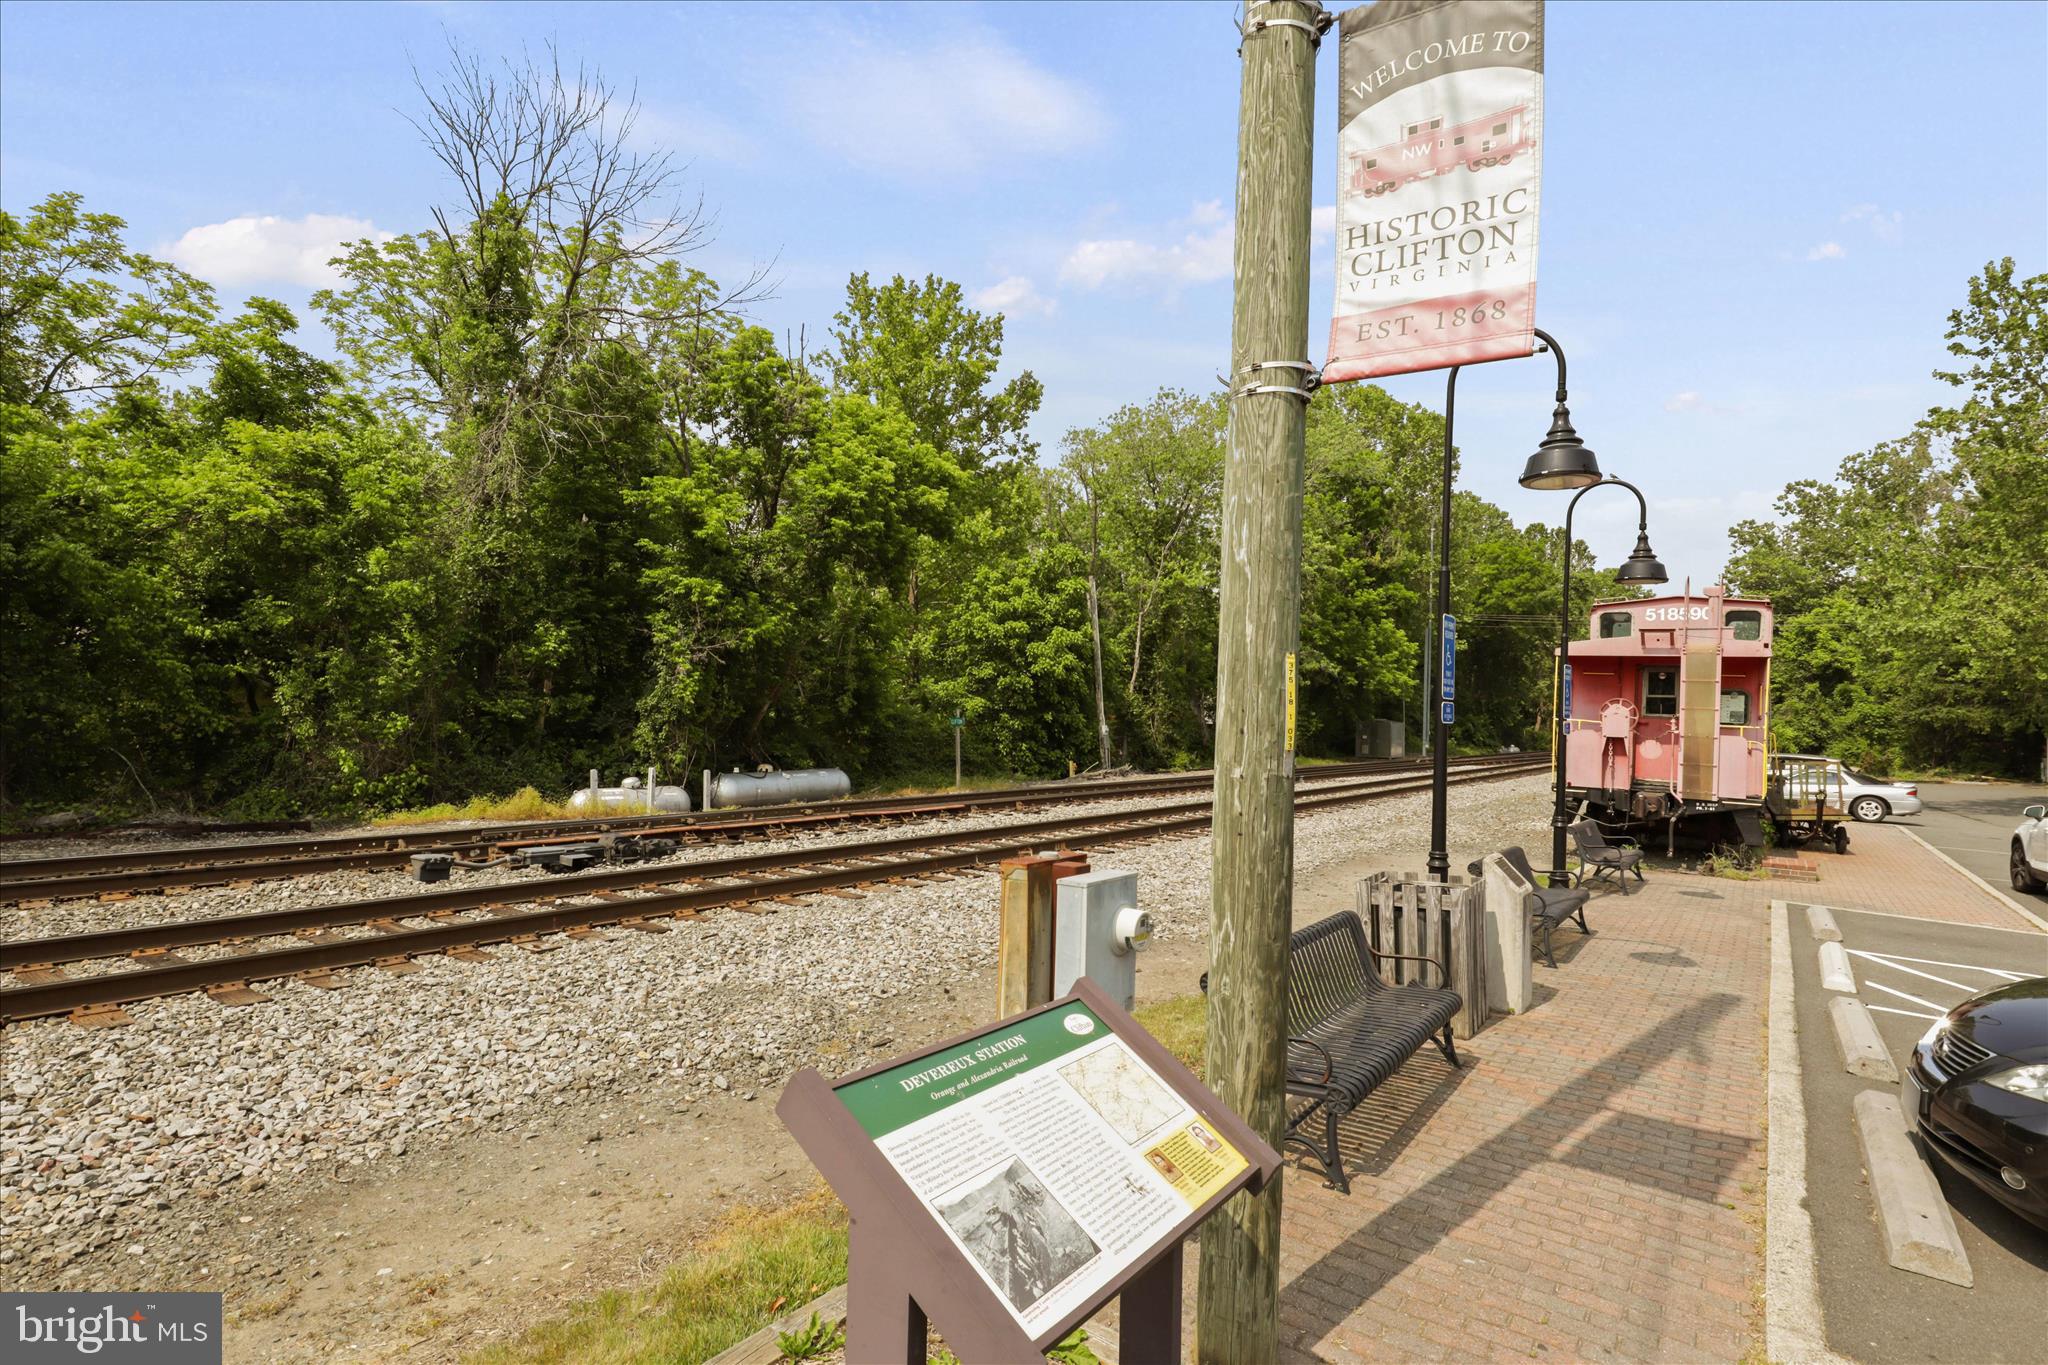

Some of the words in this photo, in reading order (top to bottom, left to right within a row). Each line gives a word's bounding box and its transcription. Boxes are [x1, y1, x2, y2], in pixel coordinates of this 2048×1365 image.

[1351, 32, 1484, 100] WELCOME
[1492, 30, 1530, 53] TO
[1402, 142, 1433, 161] NW
[1345, 187, 1528, 252] HISTORIC
[1350, 251, 1517, 293] VIRGINIA
[1351, 220, 1519, 278] CLIFTON
[1356, 315, 1419, 344] EST.
[1436, 299, 1507, 331] 1868
[899, 1054, 977, 1092] DEVEREUX
[975, 1034, 1027, 1061] STATION
[930, 1086, 956, 1100] Orange
[956, 1079, 970, 1090] and
[970, 1065, 1004, 1084] Alexandria
[1002, 1054, 1029, 1069] Railroad
